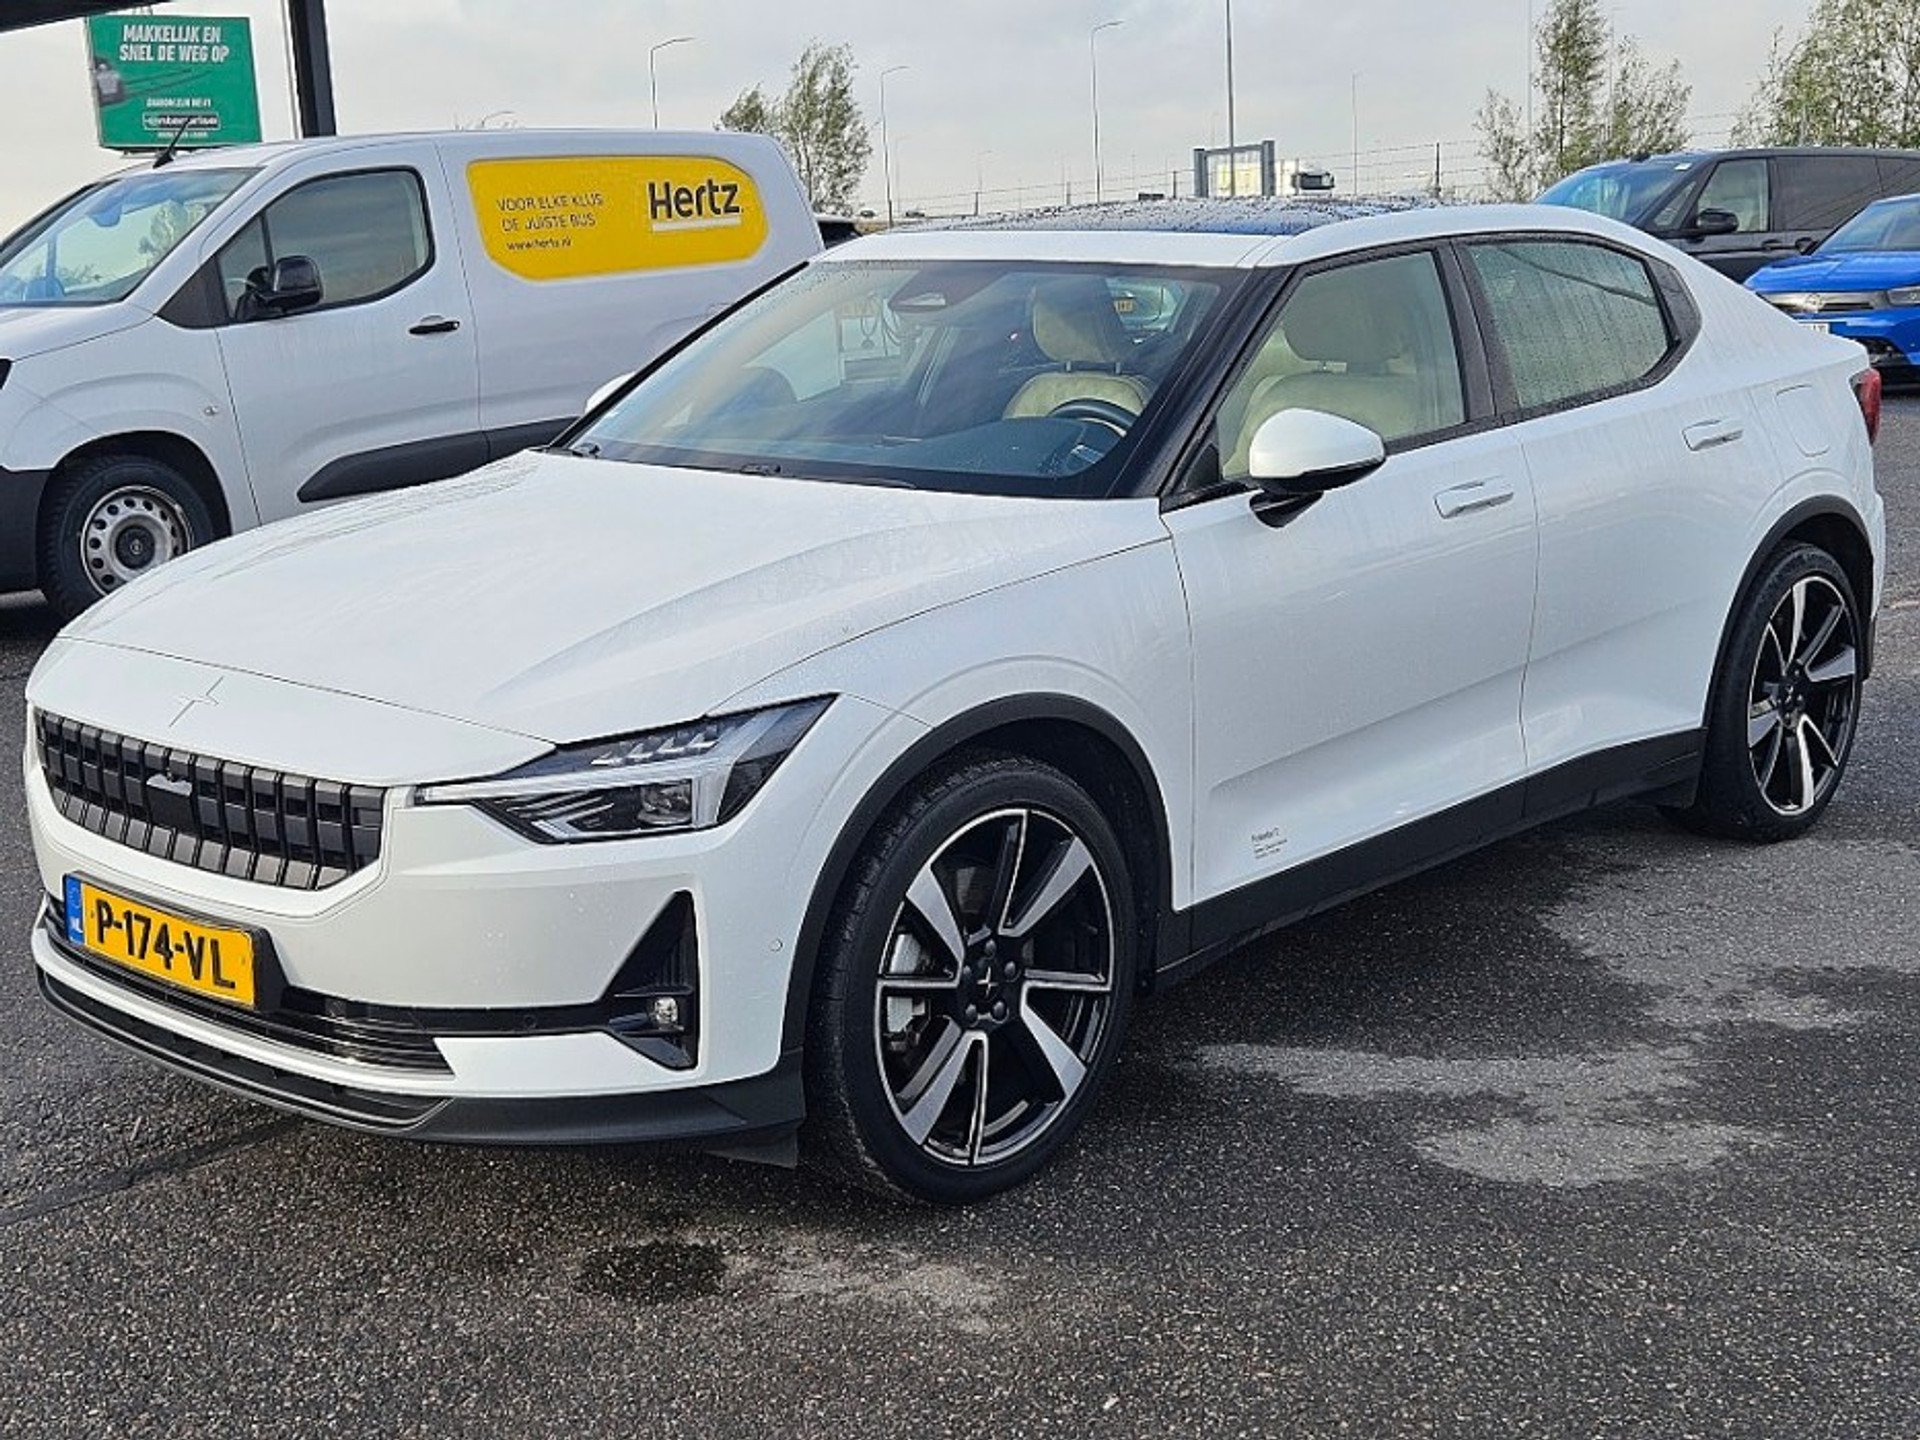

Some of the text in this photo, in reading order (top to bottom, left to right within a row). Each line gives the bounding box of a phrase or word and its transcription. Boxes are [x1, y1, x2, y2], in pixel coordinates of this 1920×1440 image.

[123, 24, 221, 43] MAKKELIJK EN
[119, 43, 229, 63] SNEL DE WEG OP
[497, 193, 603, 211] VOOR ELKE KLUS
[648, 179, 740, 219] Hertz
[502, 212, 596, 232] DE JUISTE BUS
[96, 898, 235, 989] P-174-VL
